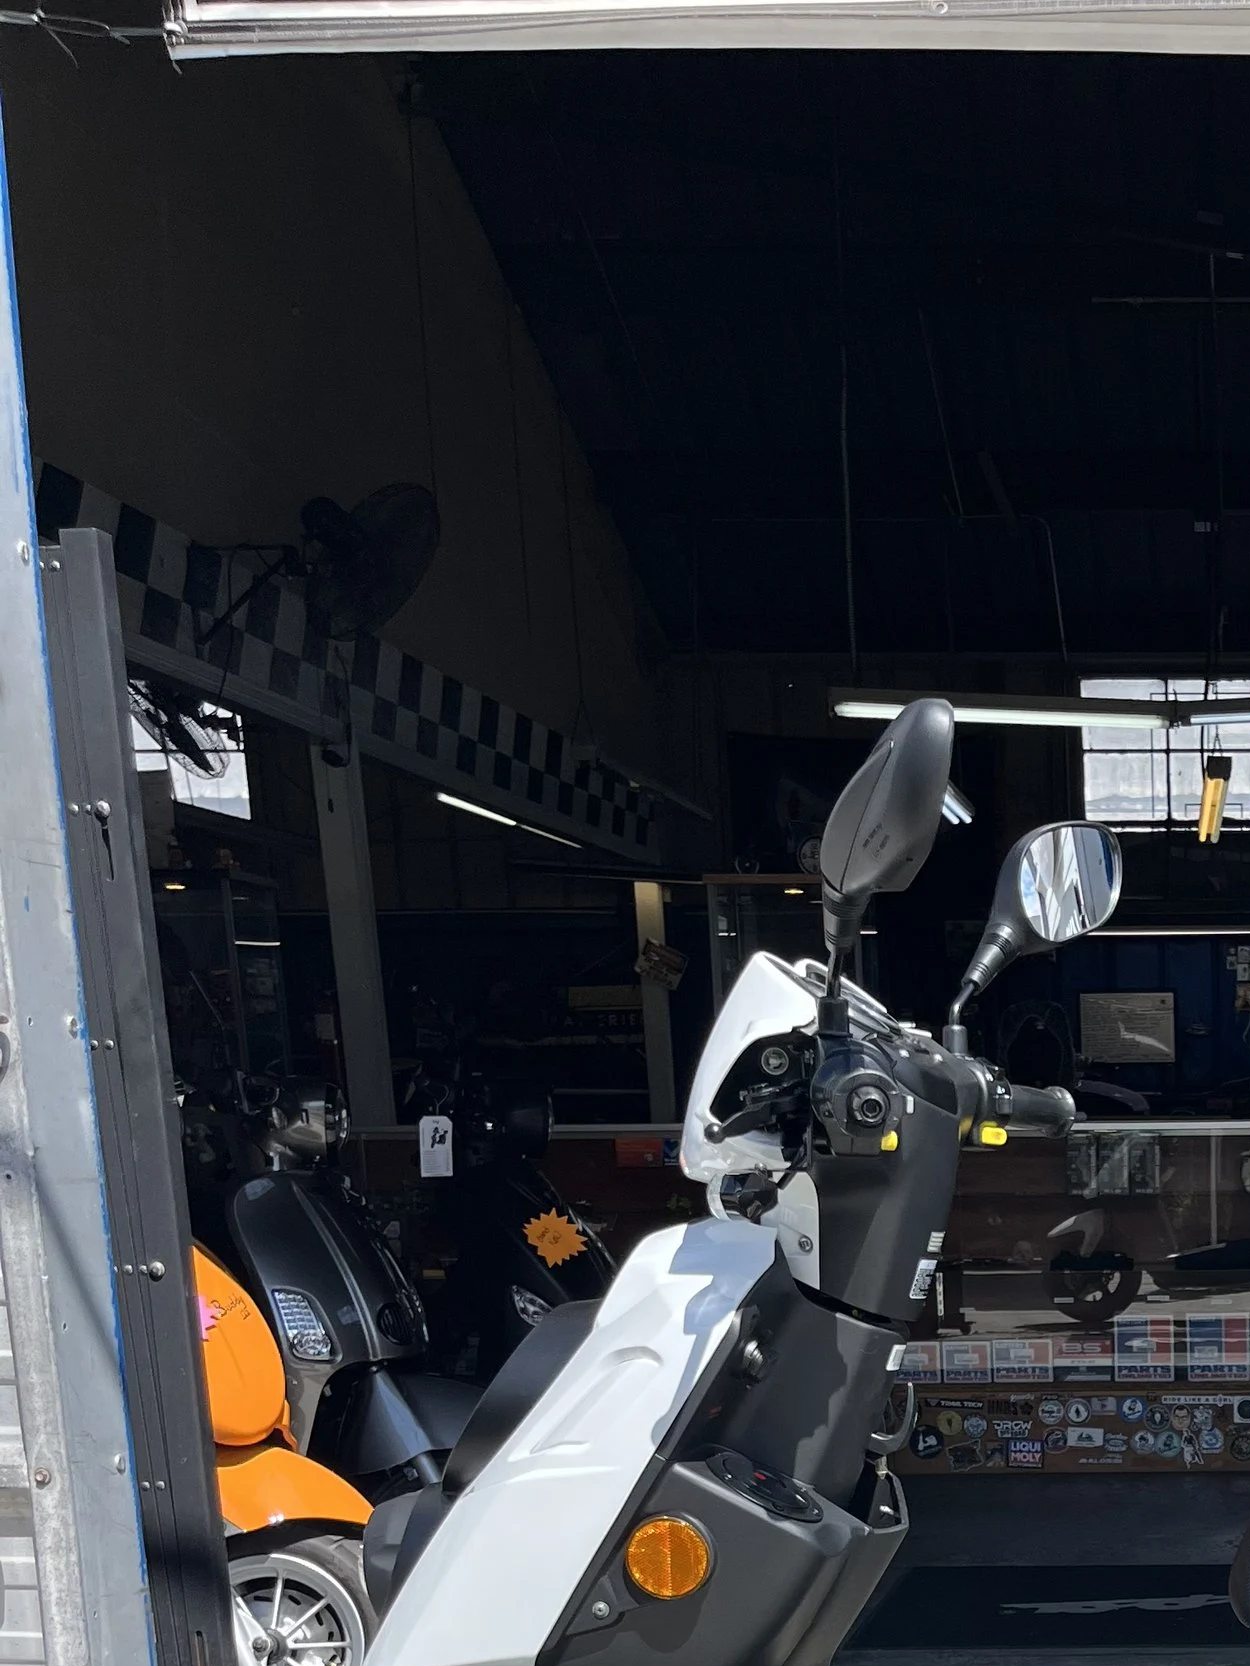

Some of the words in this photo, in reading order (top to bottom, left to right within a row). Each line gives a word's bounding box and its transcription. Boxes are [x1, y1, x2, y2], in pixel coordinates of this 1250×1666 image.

[1062, 1342, 1103, 1353] BS
[996, 1366, 1049, 1374] PARTS
[1118, 1365, 1171, 1373] PARTS
[1190, 1365, 1248, 1373] PARTS
[1011, 1441, 1042, 1451] LIQUI
[1010, 1452, 1042, 1463] MOLY
